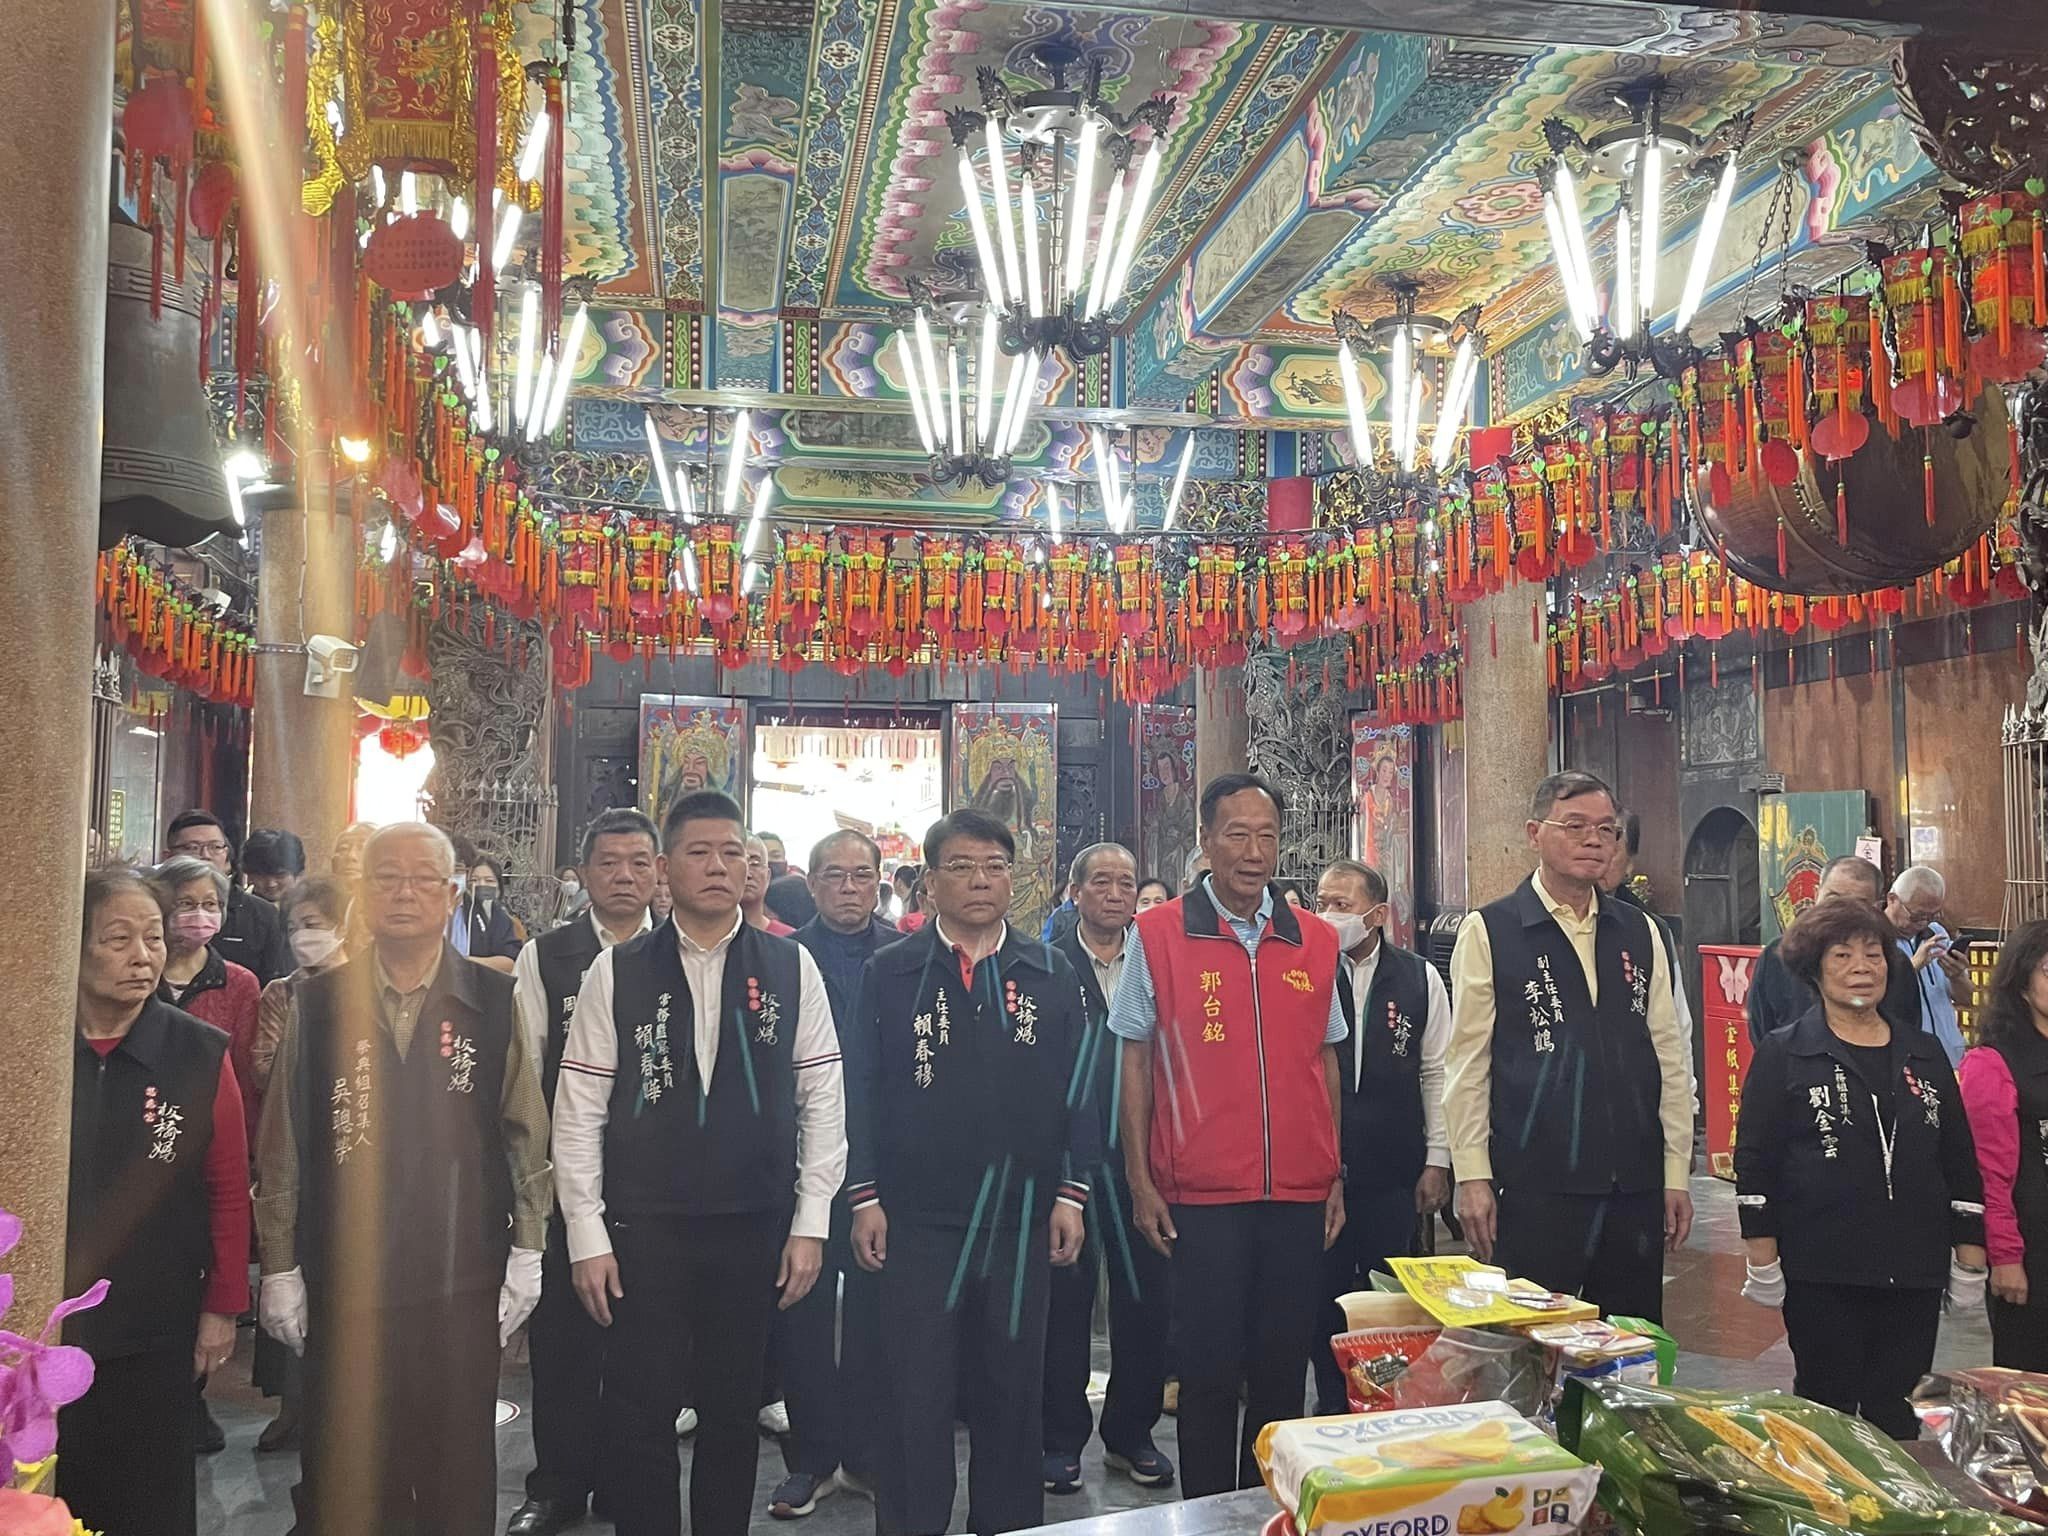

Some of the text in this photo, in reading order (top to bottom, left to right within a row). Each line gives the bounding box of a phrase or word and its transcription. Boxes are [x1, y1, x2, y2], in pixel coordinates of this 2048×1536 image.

[936, 987, 951, 1045] 主任委員
[1199, 970, 1225, 1042] 郭台銘
[1523, 980, 1555, 1053] 李松鶴
[1537, 954, 1564, 1023] 副主任委員
[1808, 1084, 1839, 1159] 劉金雲
[1315, 1409, 1478, 1439] OXFORD
